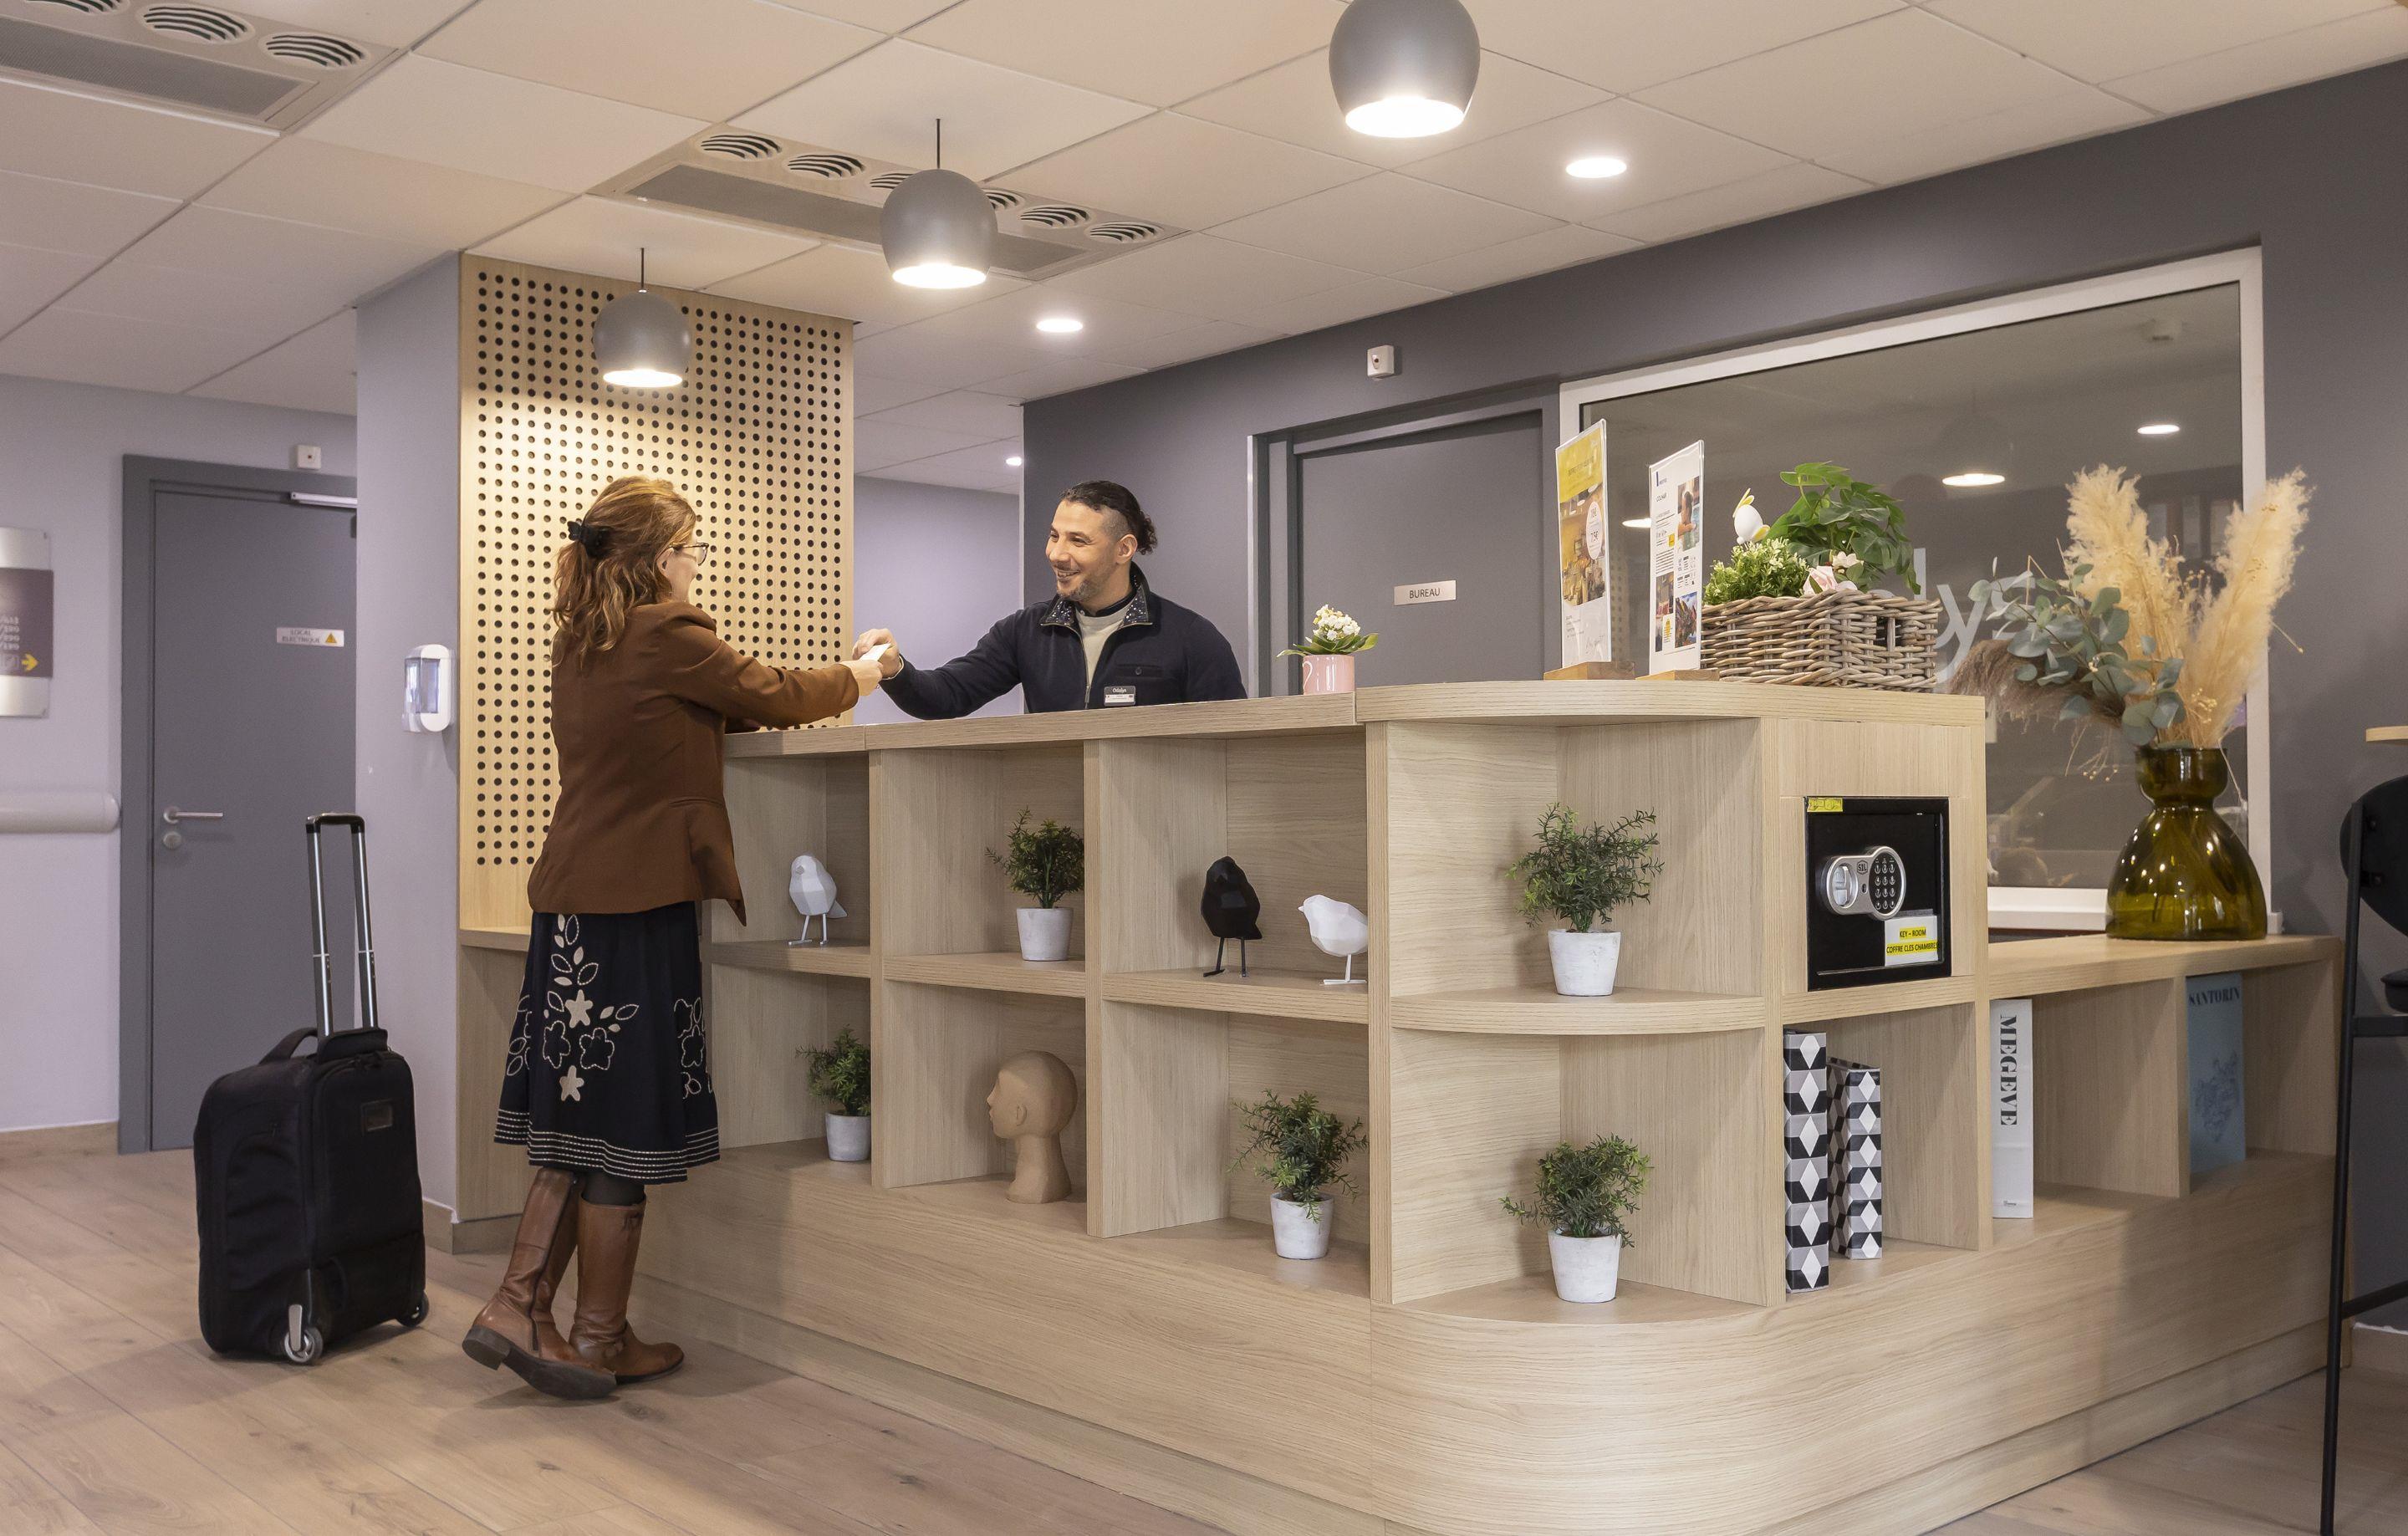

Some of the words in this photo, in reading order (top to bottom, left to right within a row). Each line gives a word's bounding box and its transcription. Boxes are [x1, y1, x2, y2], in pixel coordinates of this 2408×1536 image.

[1409, 588, 1441, 599] BUREAU
[1912, 928, 1926, 936] ROOM
[1886, 945, 1903, 953] COFFRE
[2188, 987, 2240, 1005] SANTORIN
[2000, 1014, 2018, 1125] MEGEVE
